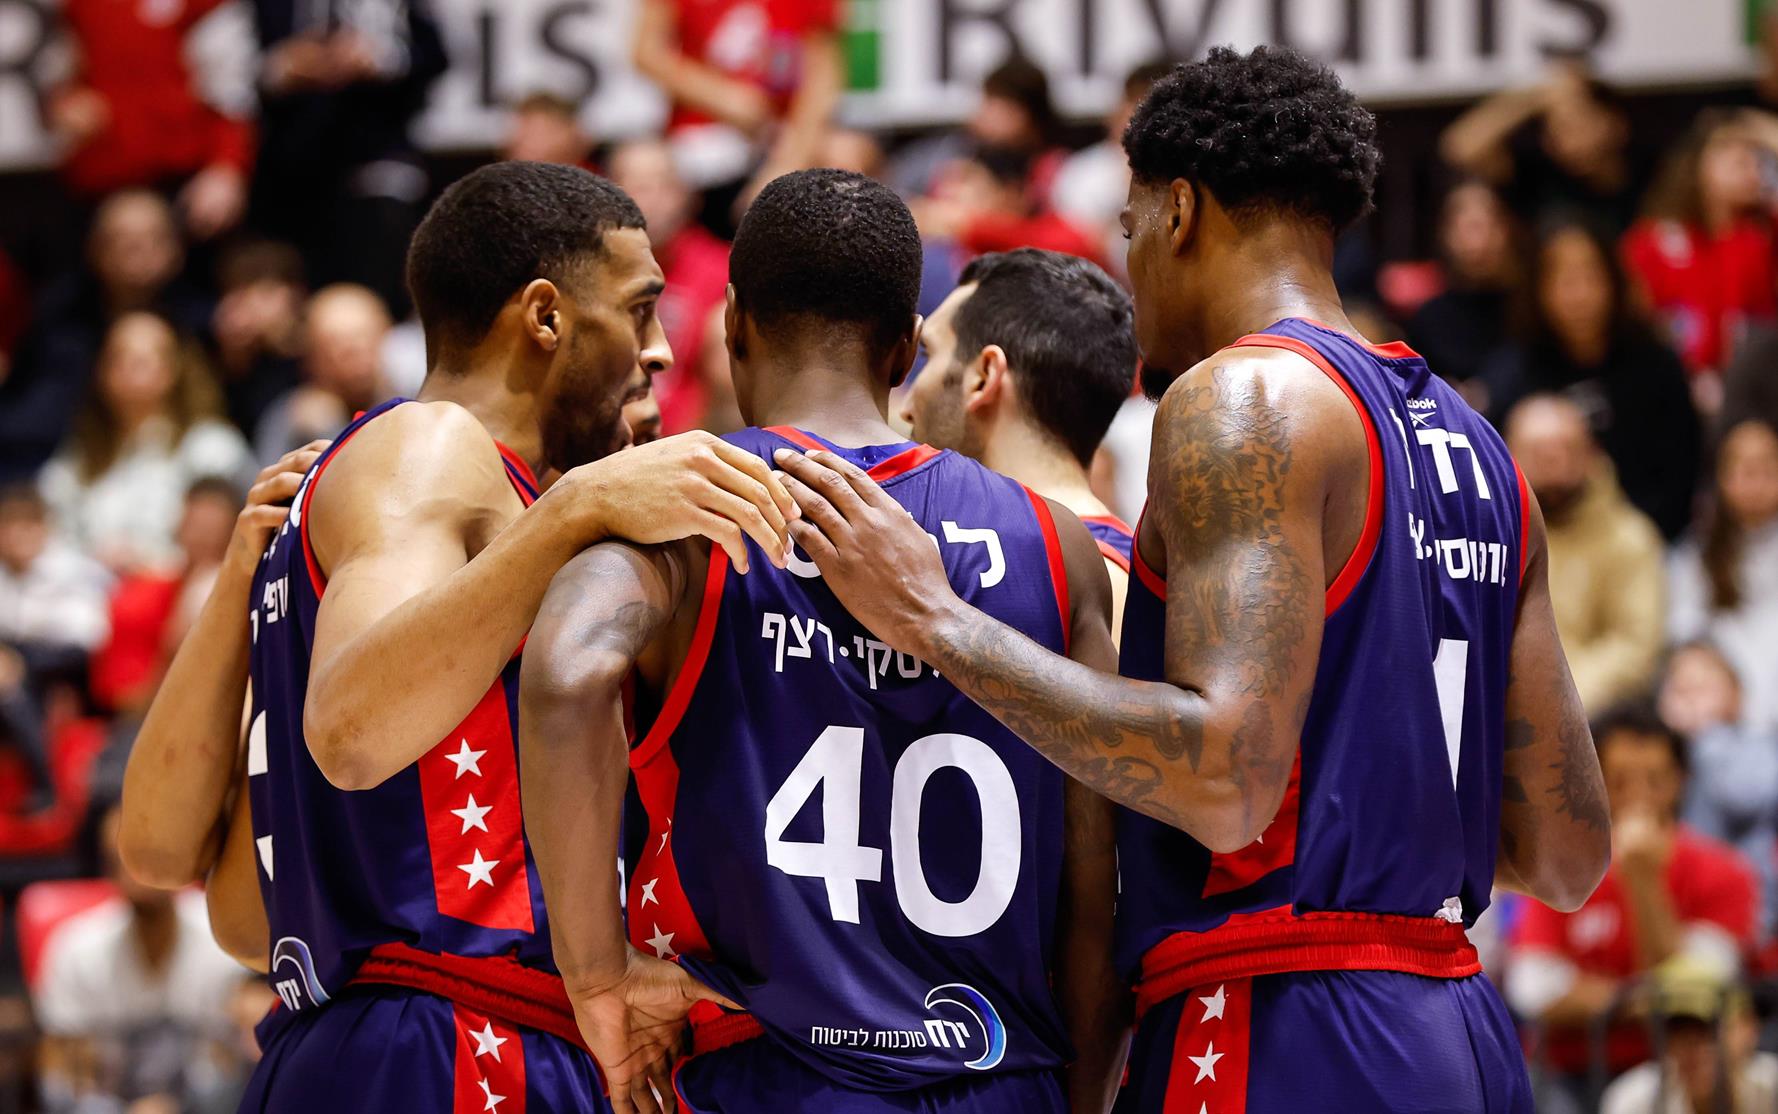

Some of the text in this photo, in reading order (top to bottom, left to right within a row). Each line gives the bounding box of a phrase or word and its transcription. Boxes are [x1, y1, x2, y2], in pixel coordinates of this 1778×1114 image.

[764, 725, 1022, 937] 40
[811, 1019, 970, 1049] ירח סוכנות לביטוח
